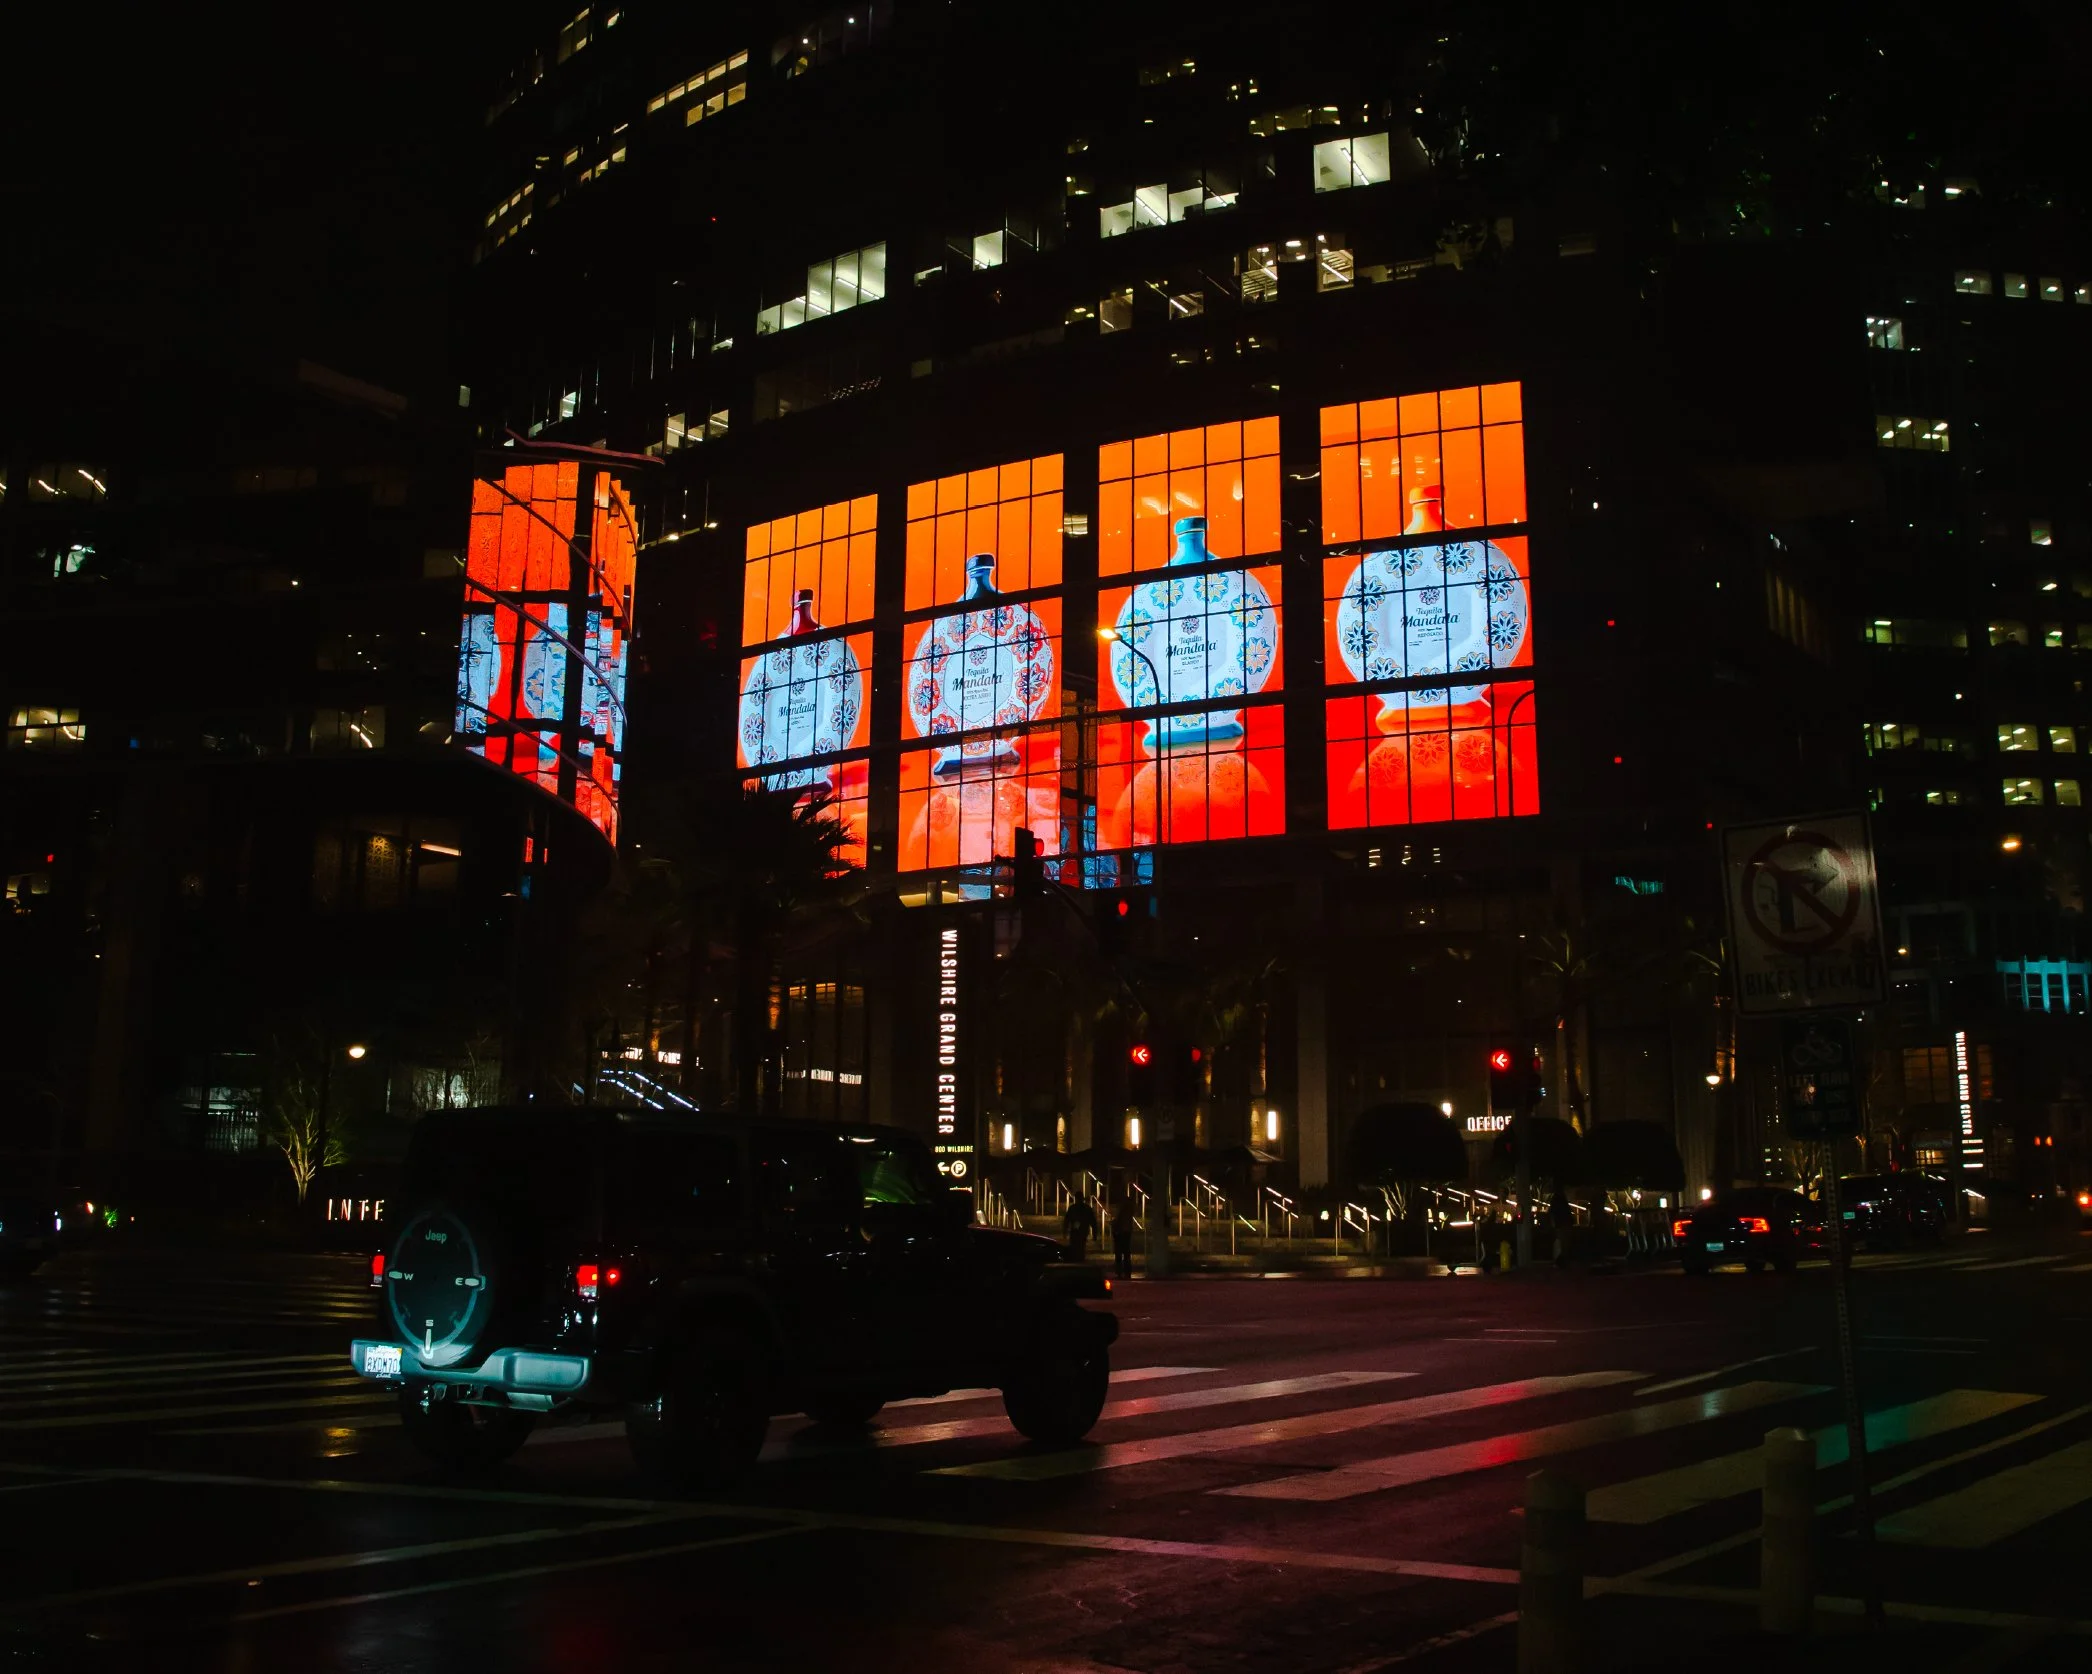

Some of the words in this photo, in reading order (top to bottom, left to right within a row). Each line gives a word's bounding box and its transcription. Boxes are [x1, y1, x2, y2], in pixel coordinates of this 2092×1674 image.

[1416, 607, 1443, 616] Tequila
[966, 666, 989, 677] Tequila
[940, 929, 958, 1005] WILSHIRE
[1745, 969, 1797, 995] BIKES
[939, 1012, 957, 1065] GRAND
[937, 1074, 956, 1135] CENTER
[947, 1145, 974, 1153] WILSHIRE
[424, 1229, 447, 1245] Jeep
[404, 1273, 414, 1281] W
[455, 1277, 463, 1286] E
